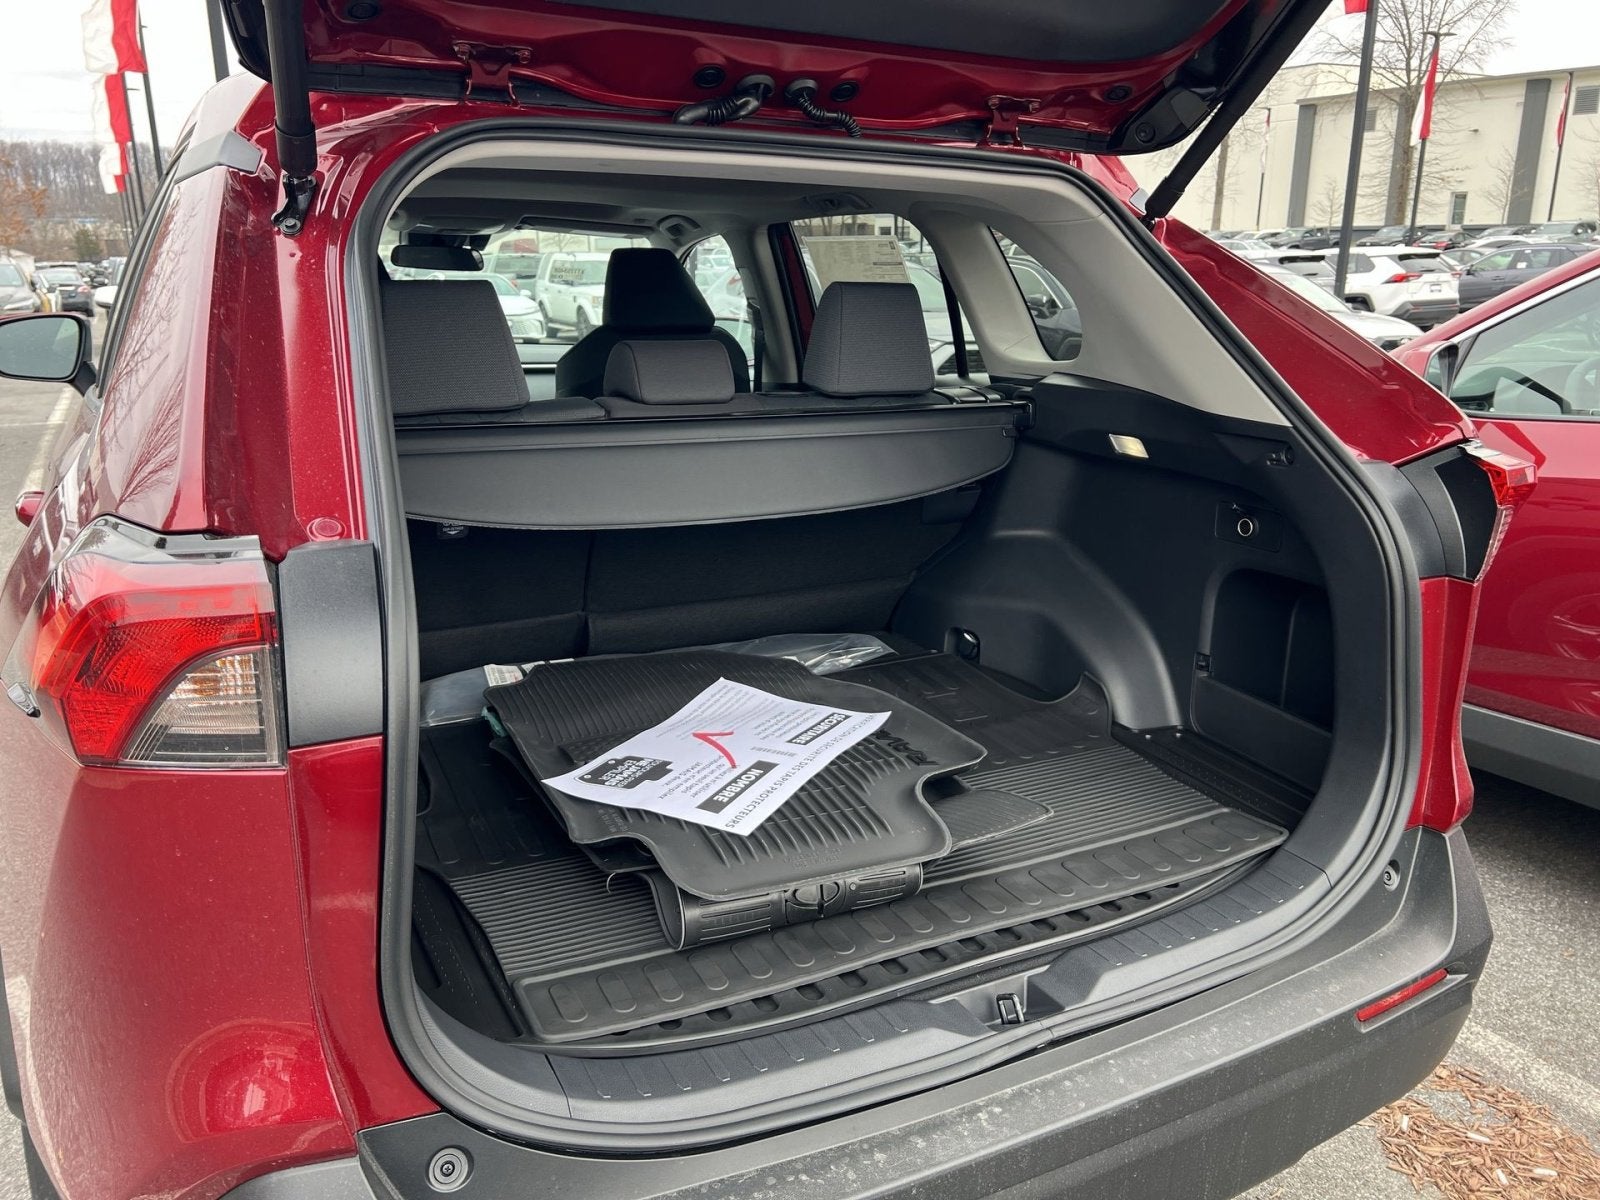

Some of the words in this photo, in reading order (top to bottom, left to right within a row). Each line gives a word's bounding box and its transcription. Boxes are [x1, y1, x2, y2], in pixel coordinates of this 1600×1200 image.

[604, 765, 642, 786] JAMAIS
[789, 760, 810, 771] DES
[711, 768, 764, 802] NOMBRE
[771, 771, 796, 786] TAPIS
[722, 785, 779, 828] PROTECTEURS
